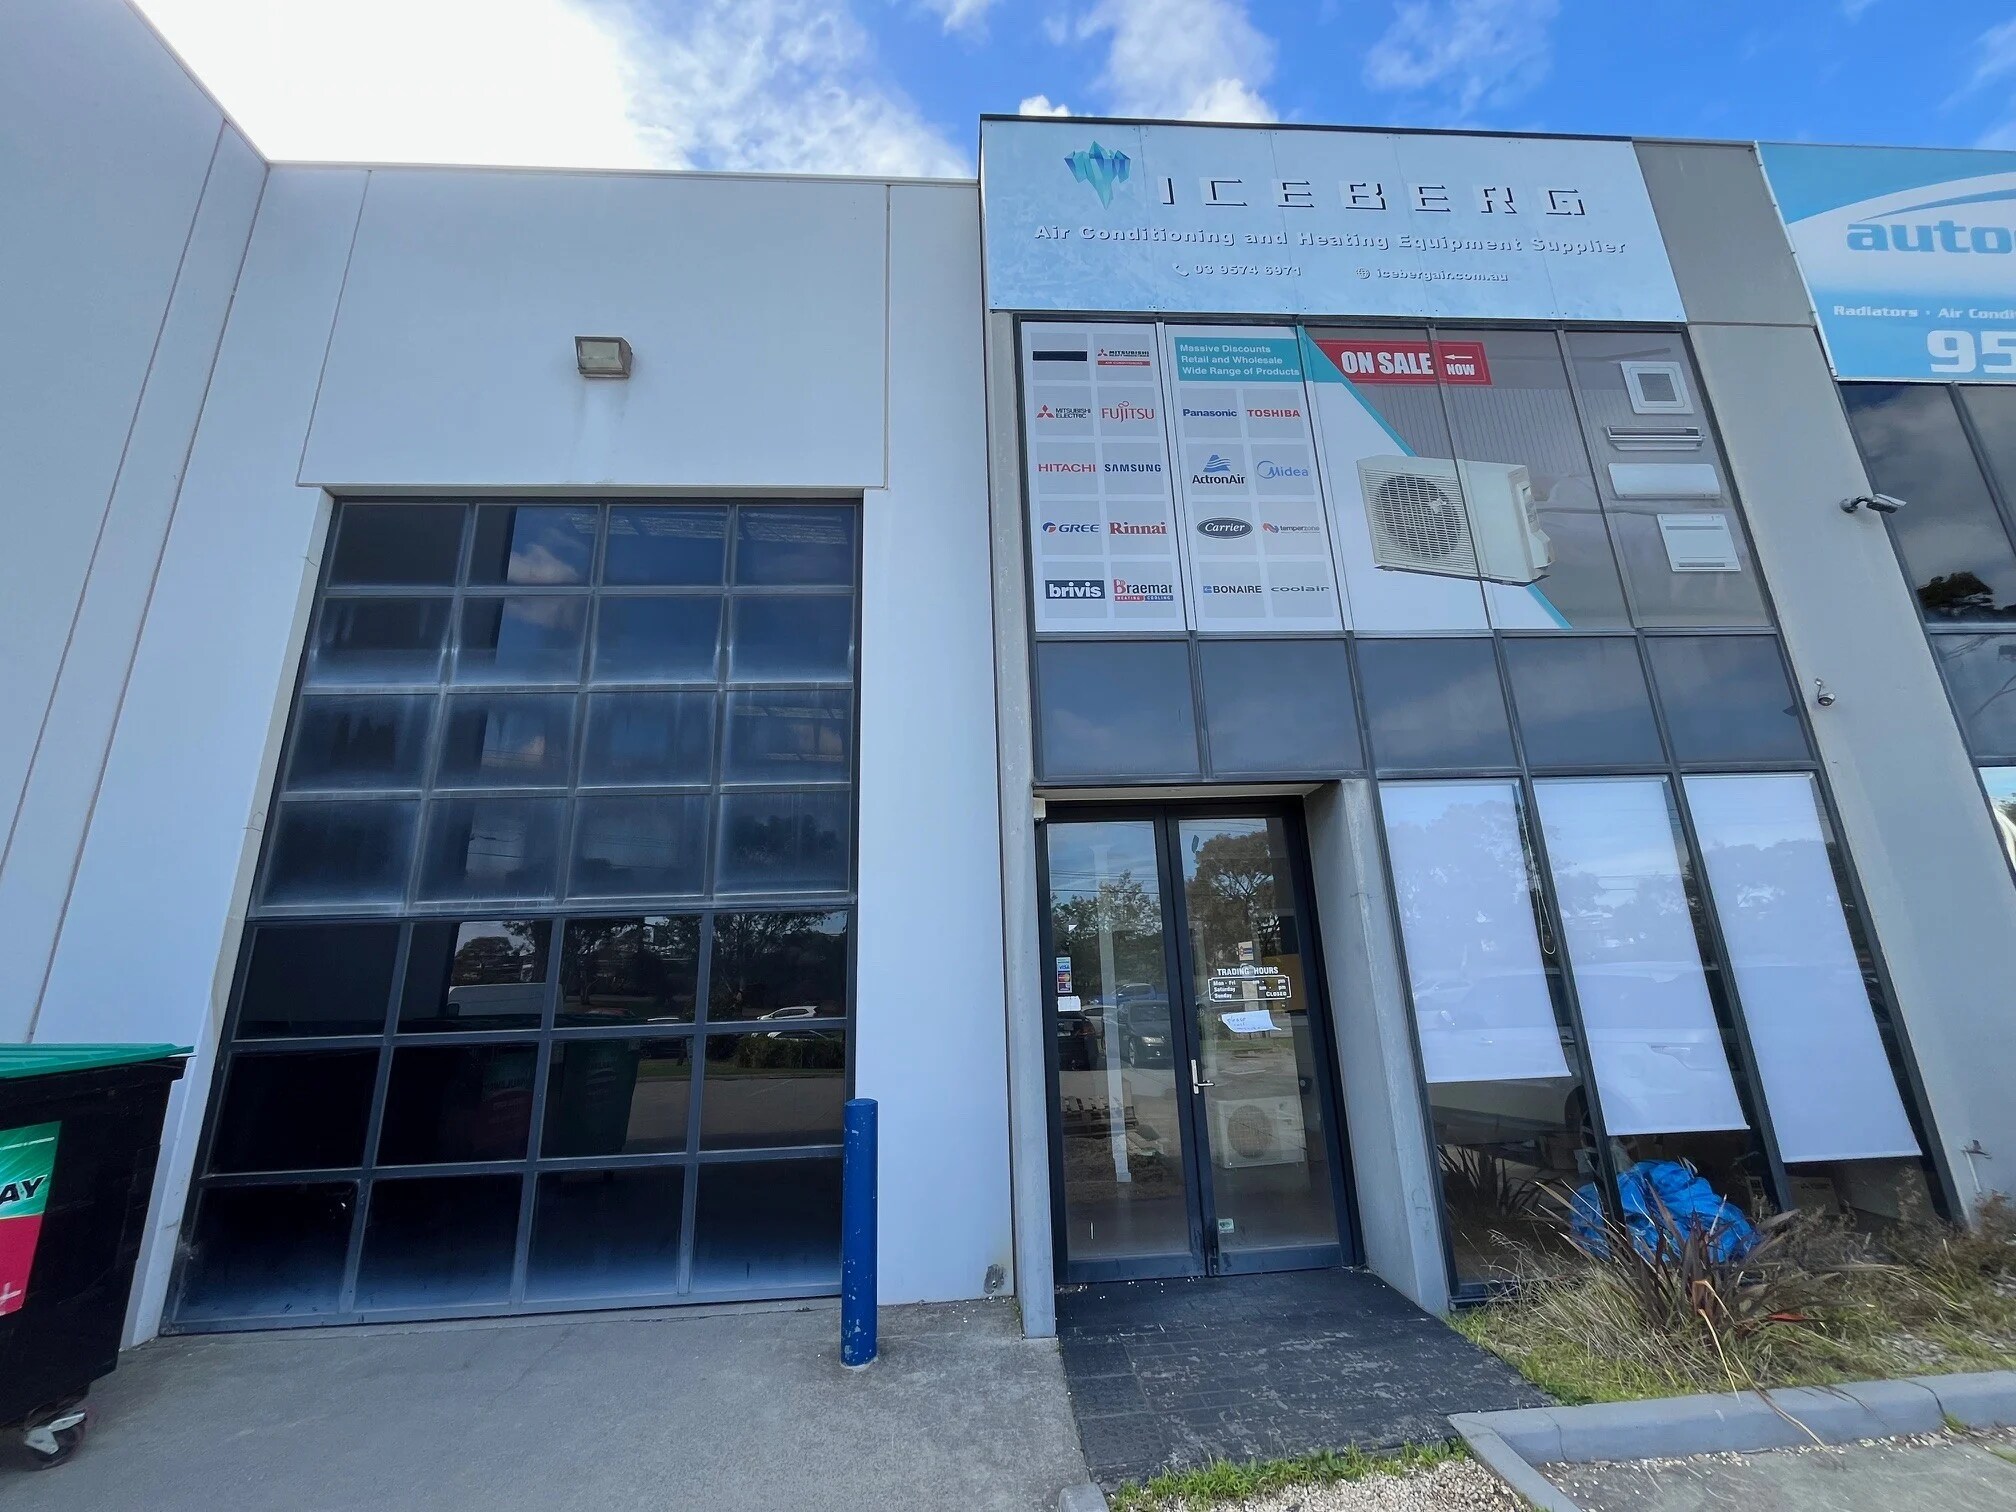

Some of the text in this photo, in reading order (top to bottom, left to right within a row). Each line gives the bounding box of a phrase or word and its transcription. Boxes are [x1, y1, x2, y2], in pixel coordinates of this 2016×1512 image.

[1157, 176, 1586, 216] ICEBERG
[1034, 225, 1626, 255] Air Conditioning and Heating Equipment Supplier
[1846, 220, 2016, 254] auto
[1195, 264, 1214, 275] 03
[1220, 264, 1259, 275] 9574
[1376, 268, 1508, 282] icebergair.com.au
[1833, 305, 1918, 318] Radiators
[1938, 308, 1963, 318] Air
[1180, 344, 1271, 353] Massive Discounts
[1927, 330, 2016, 374] 95
[1181, 355, 1283, 364] Retail and Wholesale
[1341, 351, 1434, 375] ON SALE
[1182, 367, 1300, 376] Wide Range of Products
[1446, 363, 1475, 376] NOW
[1101, 403, 1155, 422] FUJITSU
[1182, 408, 1238, 417] Panasonic
[1247, 409, 1300, 418] TOSHIBA
[1038, 463, 1096, 473] HITACHI
[1104, 463, 1162, 473] SAMSUNG
[1267, 466, 1310, 477] Midea
[1192, 474, 1246, 485] ActronAir
[1058, 523, 1100, 533] GREE
[1109, 521, 1168, 535] Rinnai
[1204, 522, 1246, 533] Carrier
[1049, 582, 1101, 598] brivis
[1113, 579, 1173, 594] Braemar
[1213, 585, 1262, 594] BONAIRE
[1217, 966, 1279, 976] TRADING HOURS
